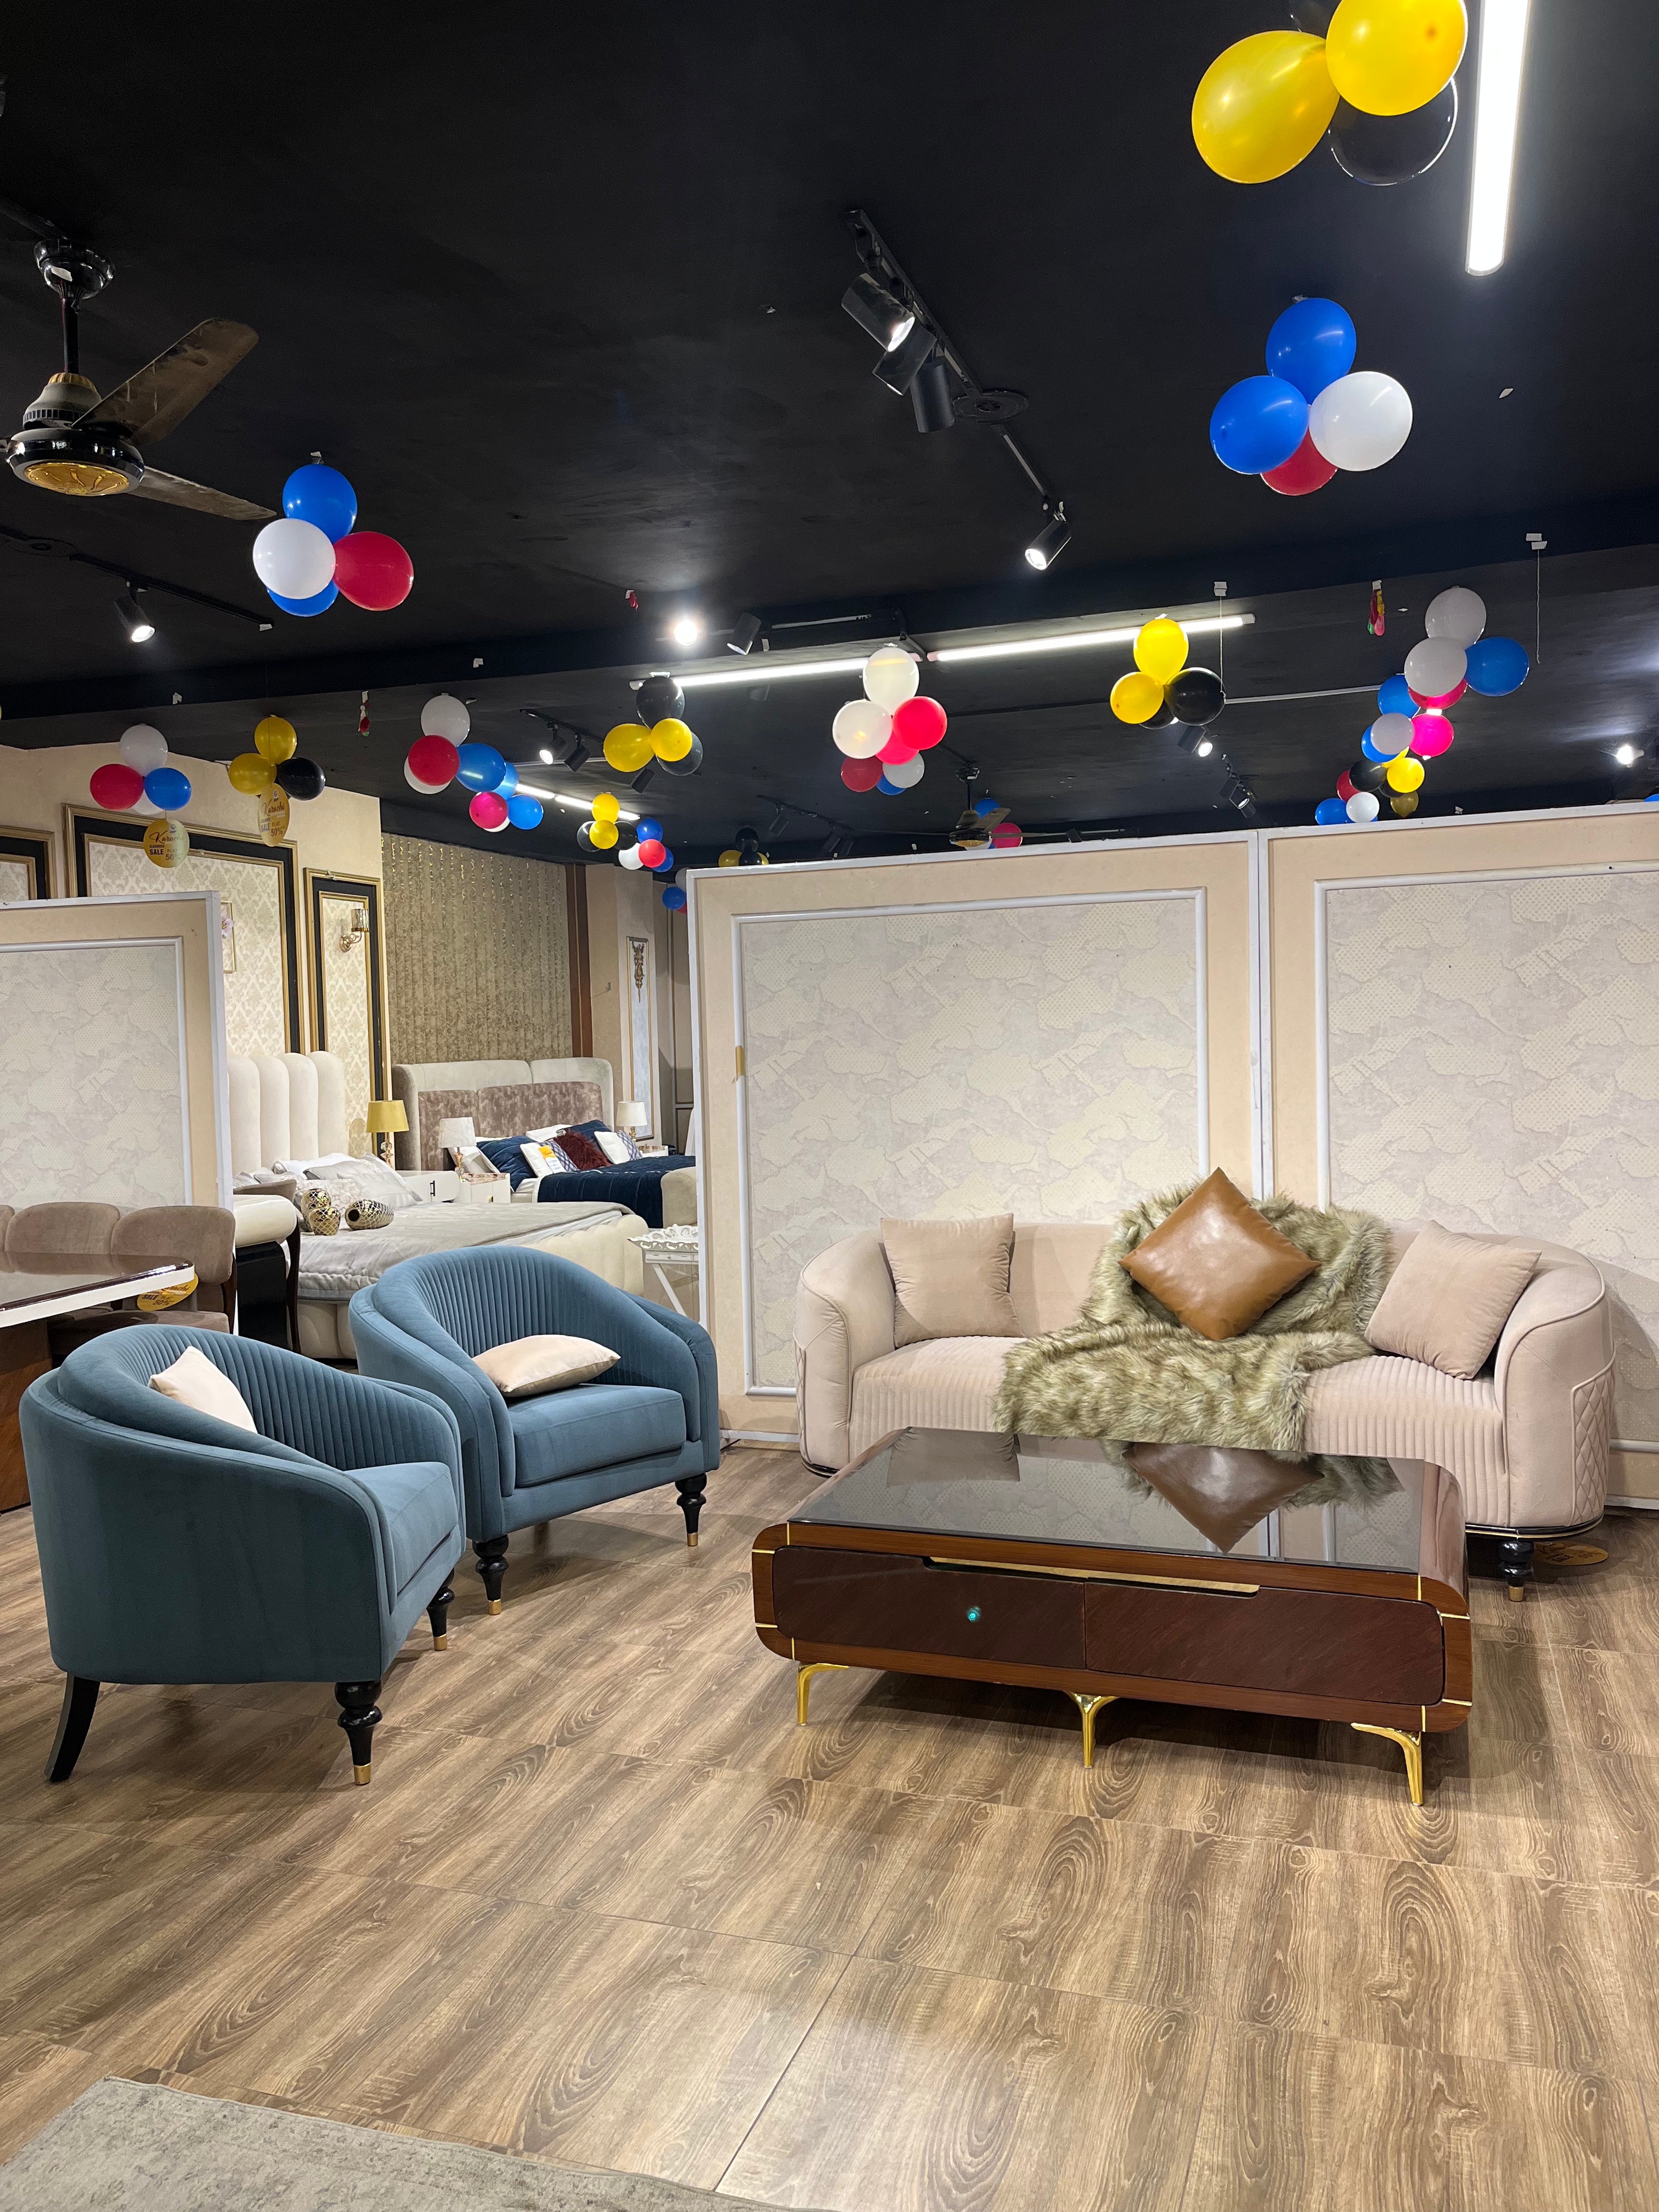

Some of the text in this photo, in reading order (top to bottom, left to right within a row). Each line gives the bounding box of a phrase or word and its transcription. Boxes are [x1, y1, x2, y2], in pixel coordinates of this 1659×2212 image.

[260, 799, 284, 816] Karachi
[149, 830, 183, 844] Karachi
[271, 828, 283, 837] 50%
